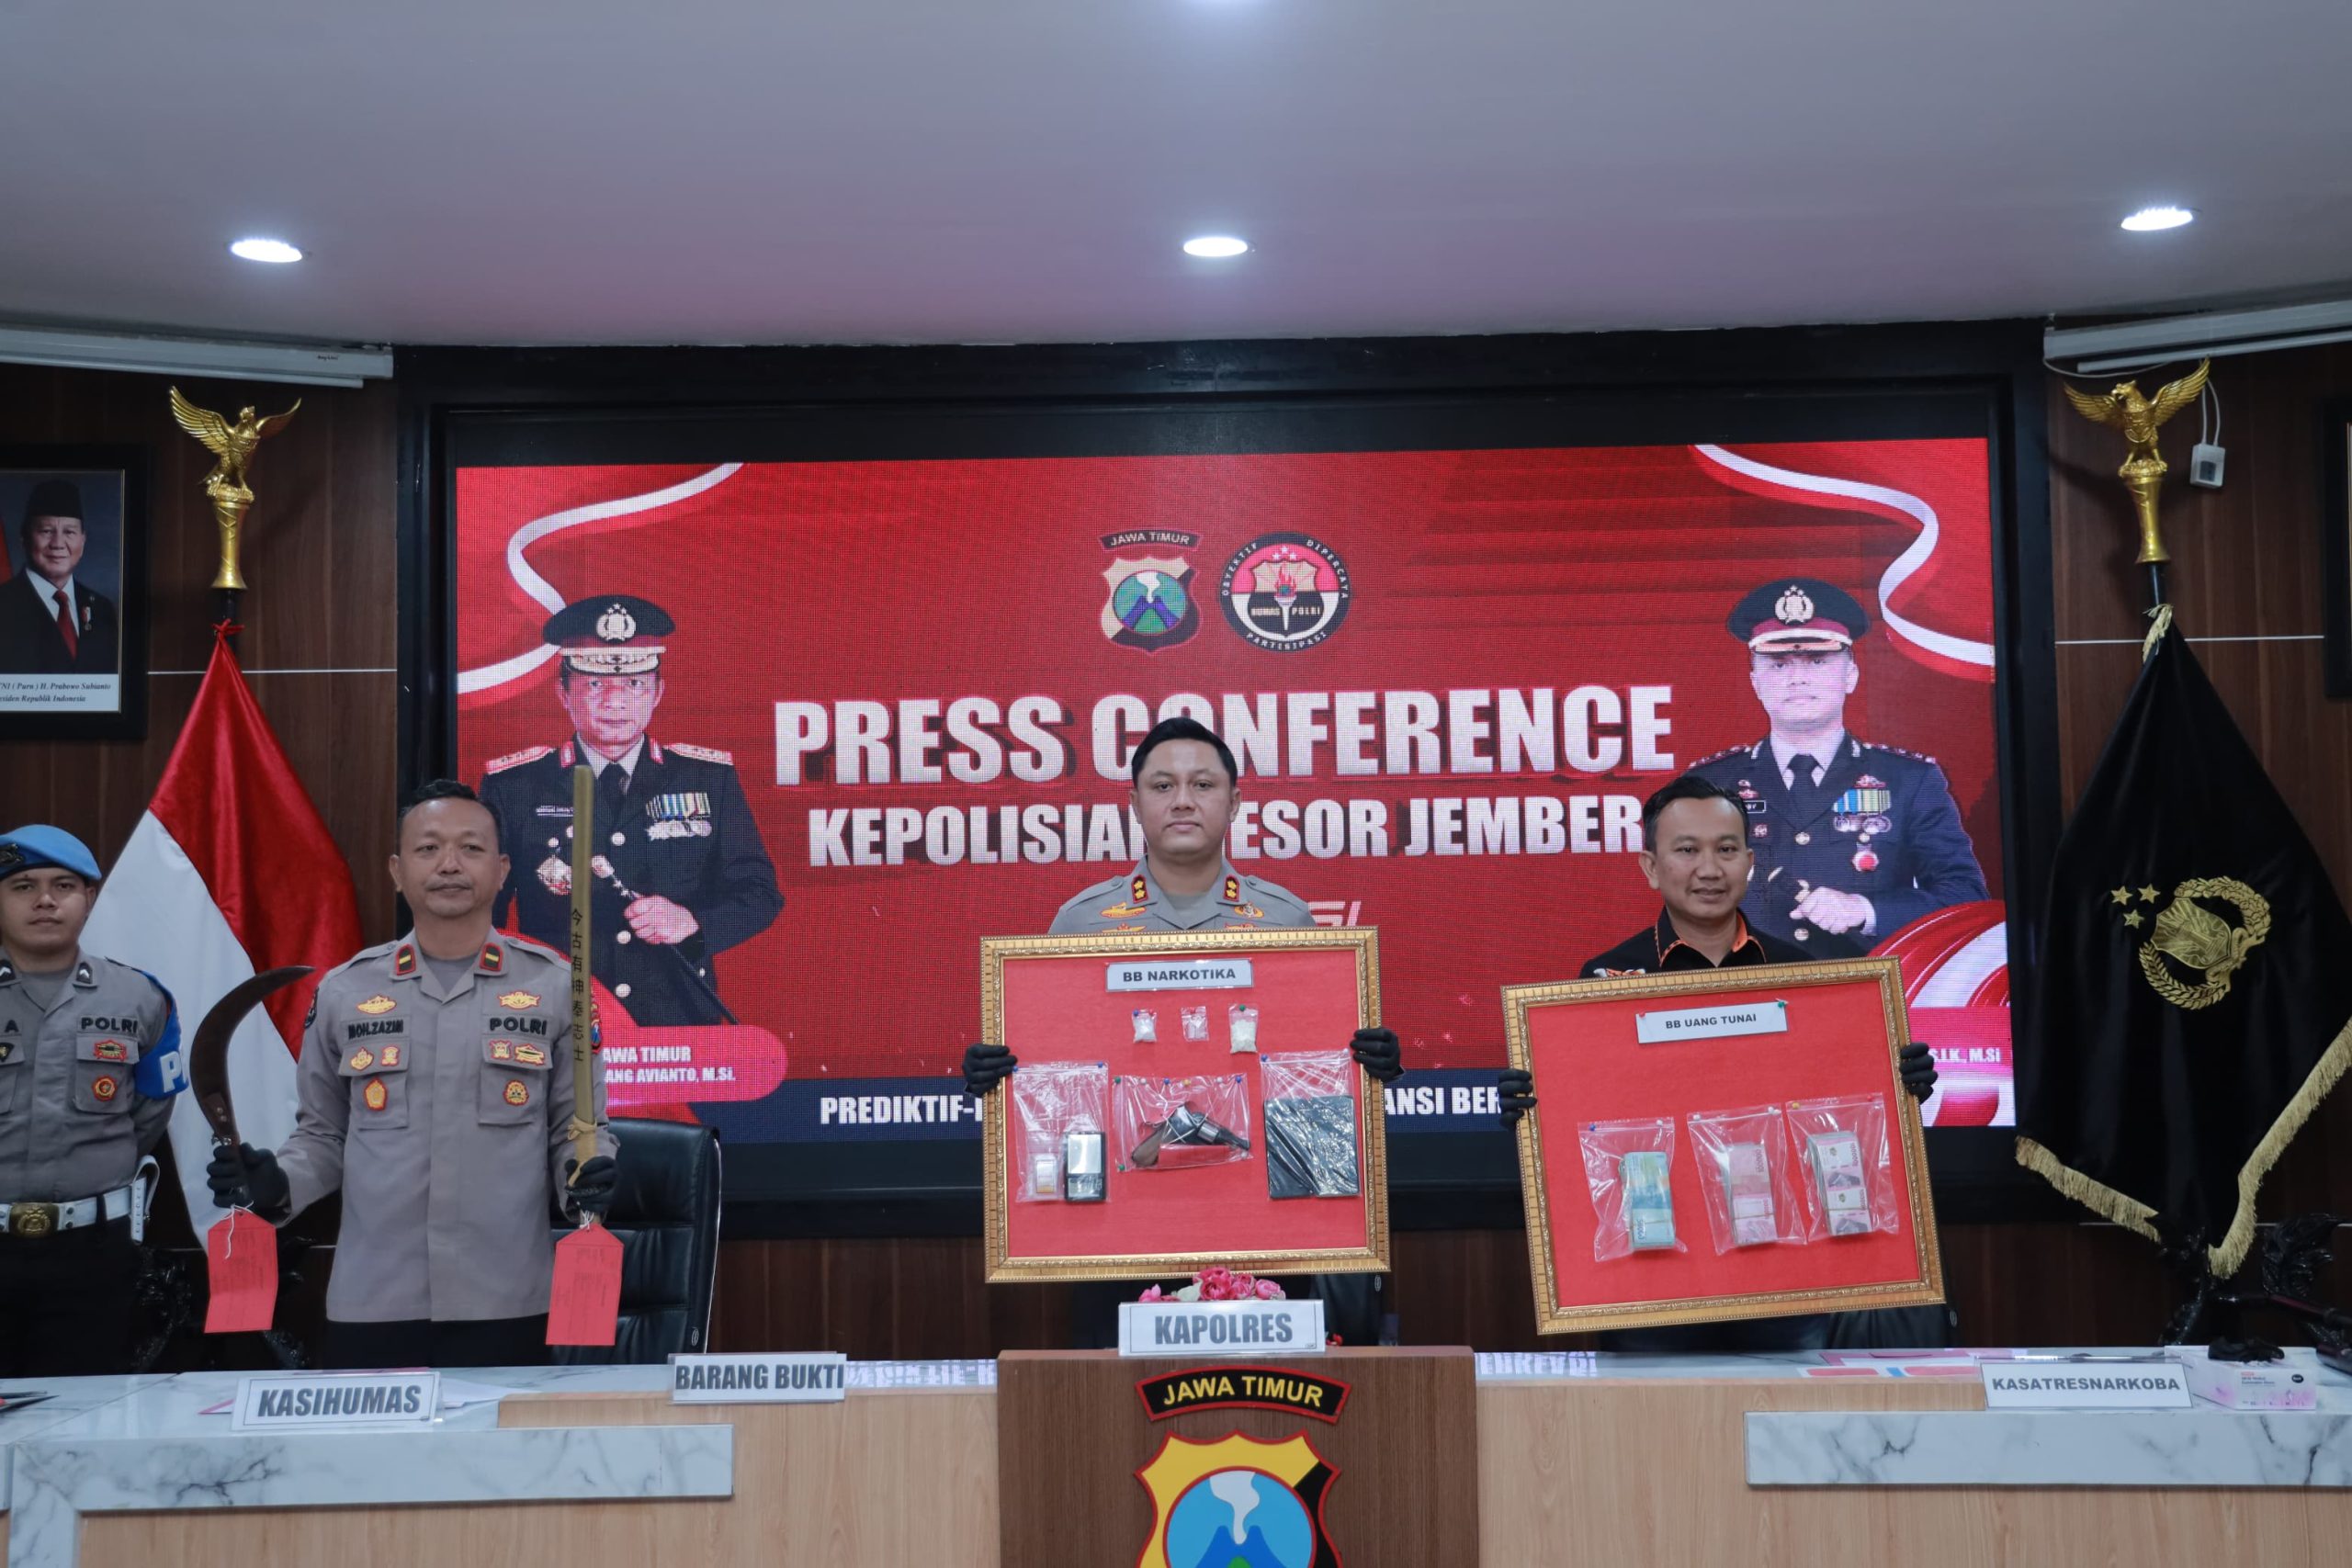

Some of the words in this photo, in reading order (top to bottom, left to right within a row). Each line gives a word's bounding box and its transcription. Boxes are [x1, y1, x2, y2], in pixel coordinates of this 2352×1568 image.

[1111, 532, 1147, 546] JAWA
[1149, 531, 1190, 545] TIMUR
[775, 695, 1065, 785] PRESS
[1222, 798, 1387, 859] ESOR
[1405, 795, 1643, 856] JEMBER
[1123, 971, 1143, 982] BB
[1148, 968, 1236, 982] NARKOTIKA
[81, 1017, 138, 1034] POLRI
[490, 1016, 548, 1036] POLRI
[1666, 1020, 1681, 1029] BB
[1685, 1017, 1717, 1027] UANG
[1721, 1013, 1757, 1024] TUNAI
[639, 1045, 692, 1063] TIMUR
[1155, 1313, 1293, 1344] KAPOLRES
[675, 1364, 769, 1390] BARANG
[775, 1364, 844, 1389] BUKTI
[1992, 1378, 2180, 1390] KASATRESNARKOBA
[257, 1384, 422, 1417] KASIHUMAS
[1163, 1376, 1235, 1405] JAWA
[1241, 1376, 1323, 1407] TIMUR
